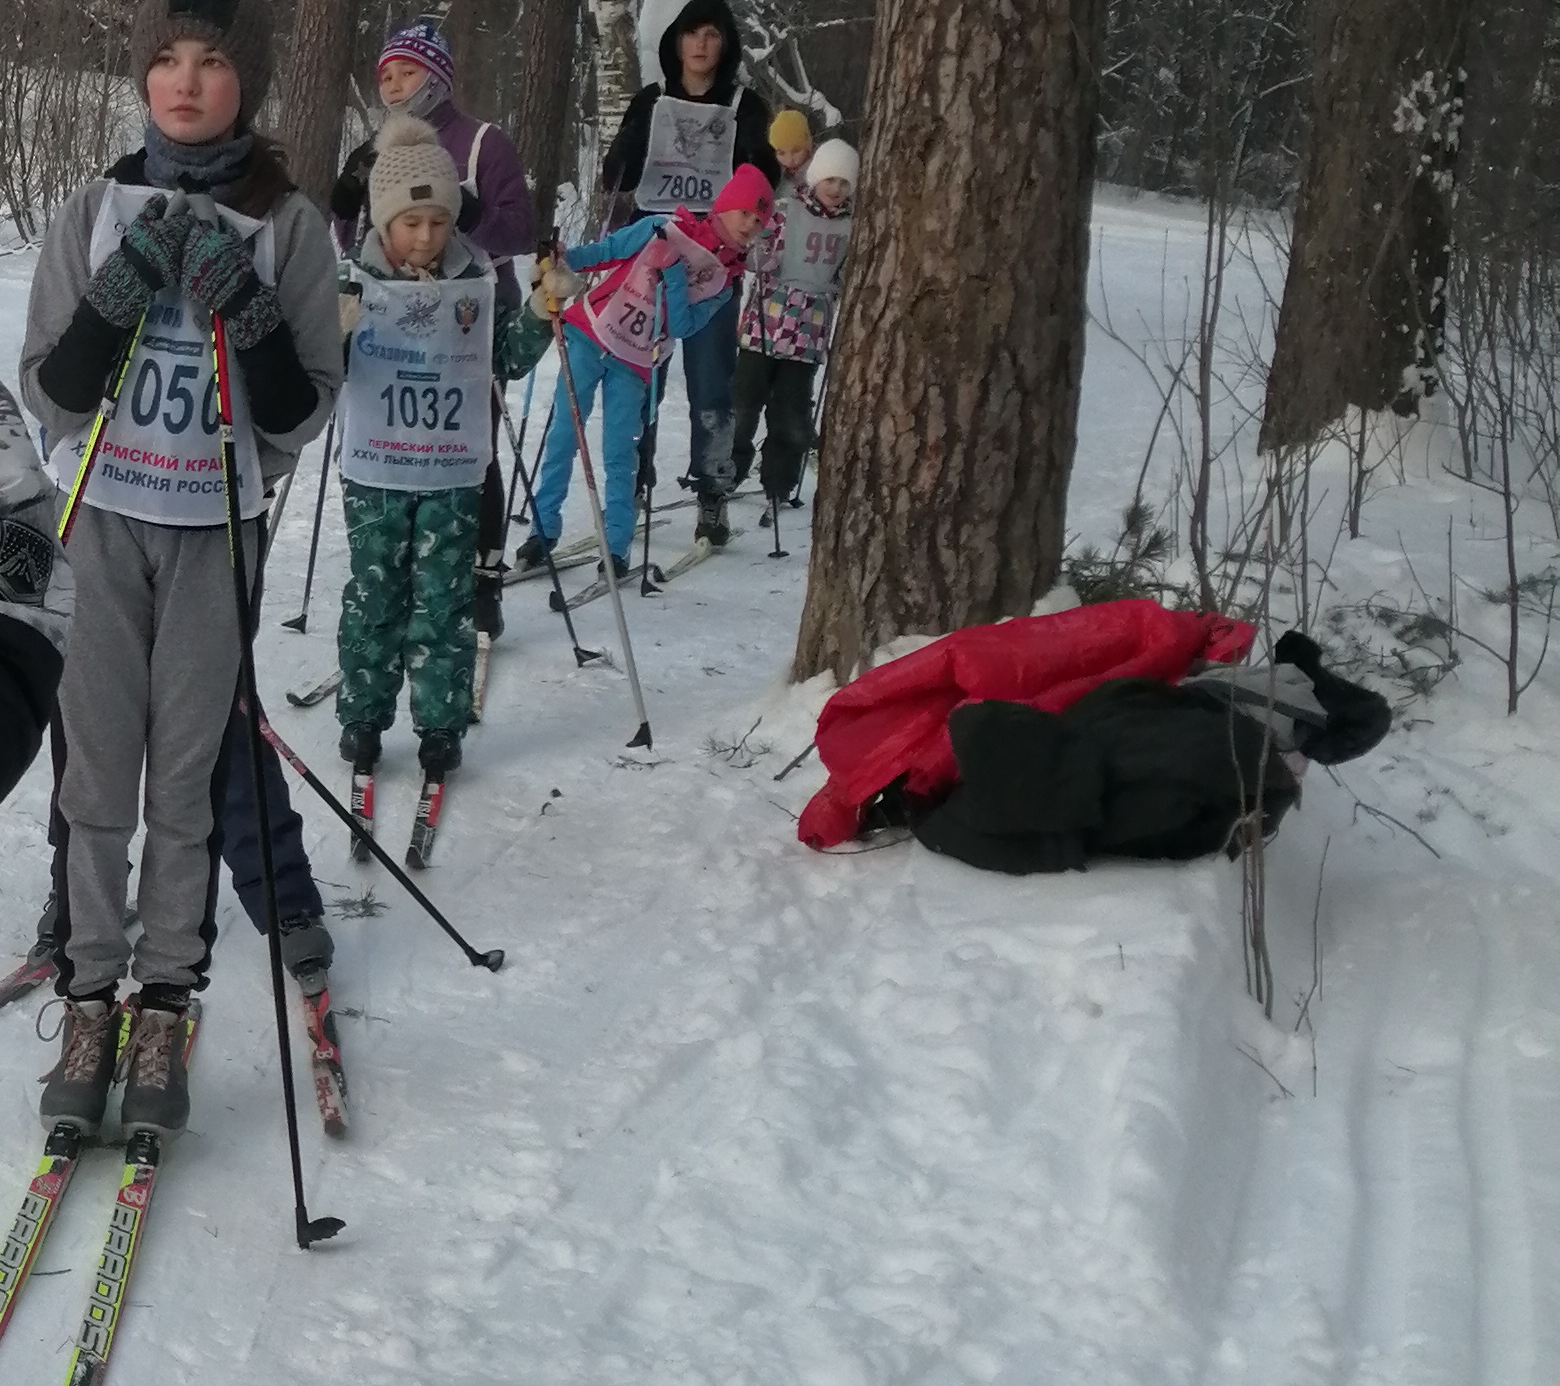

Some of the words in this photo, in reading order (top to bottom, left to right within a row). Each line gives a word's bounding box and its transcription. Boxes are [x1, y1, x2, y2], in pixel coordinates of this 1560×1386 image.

[657, 175, 714, 200] 7808
[380, 384, 464, 431] 1032
[97, 440, 179, 472] РМСКИЙ
[368, 438, 434, 453] ПЕРМСКИЙ
[438, 442, 468, 453] КРАЙ
[384, 454, 430, 467] ЛЫЖНЯ
[101, 463, 171, 492] ЛЫЖНЯ
[177, 473, 244, 494] РОССИ
